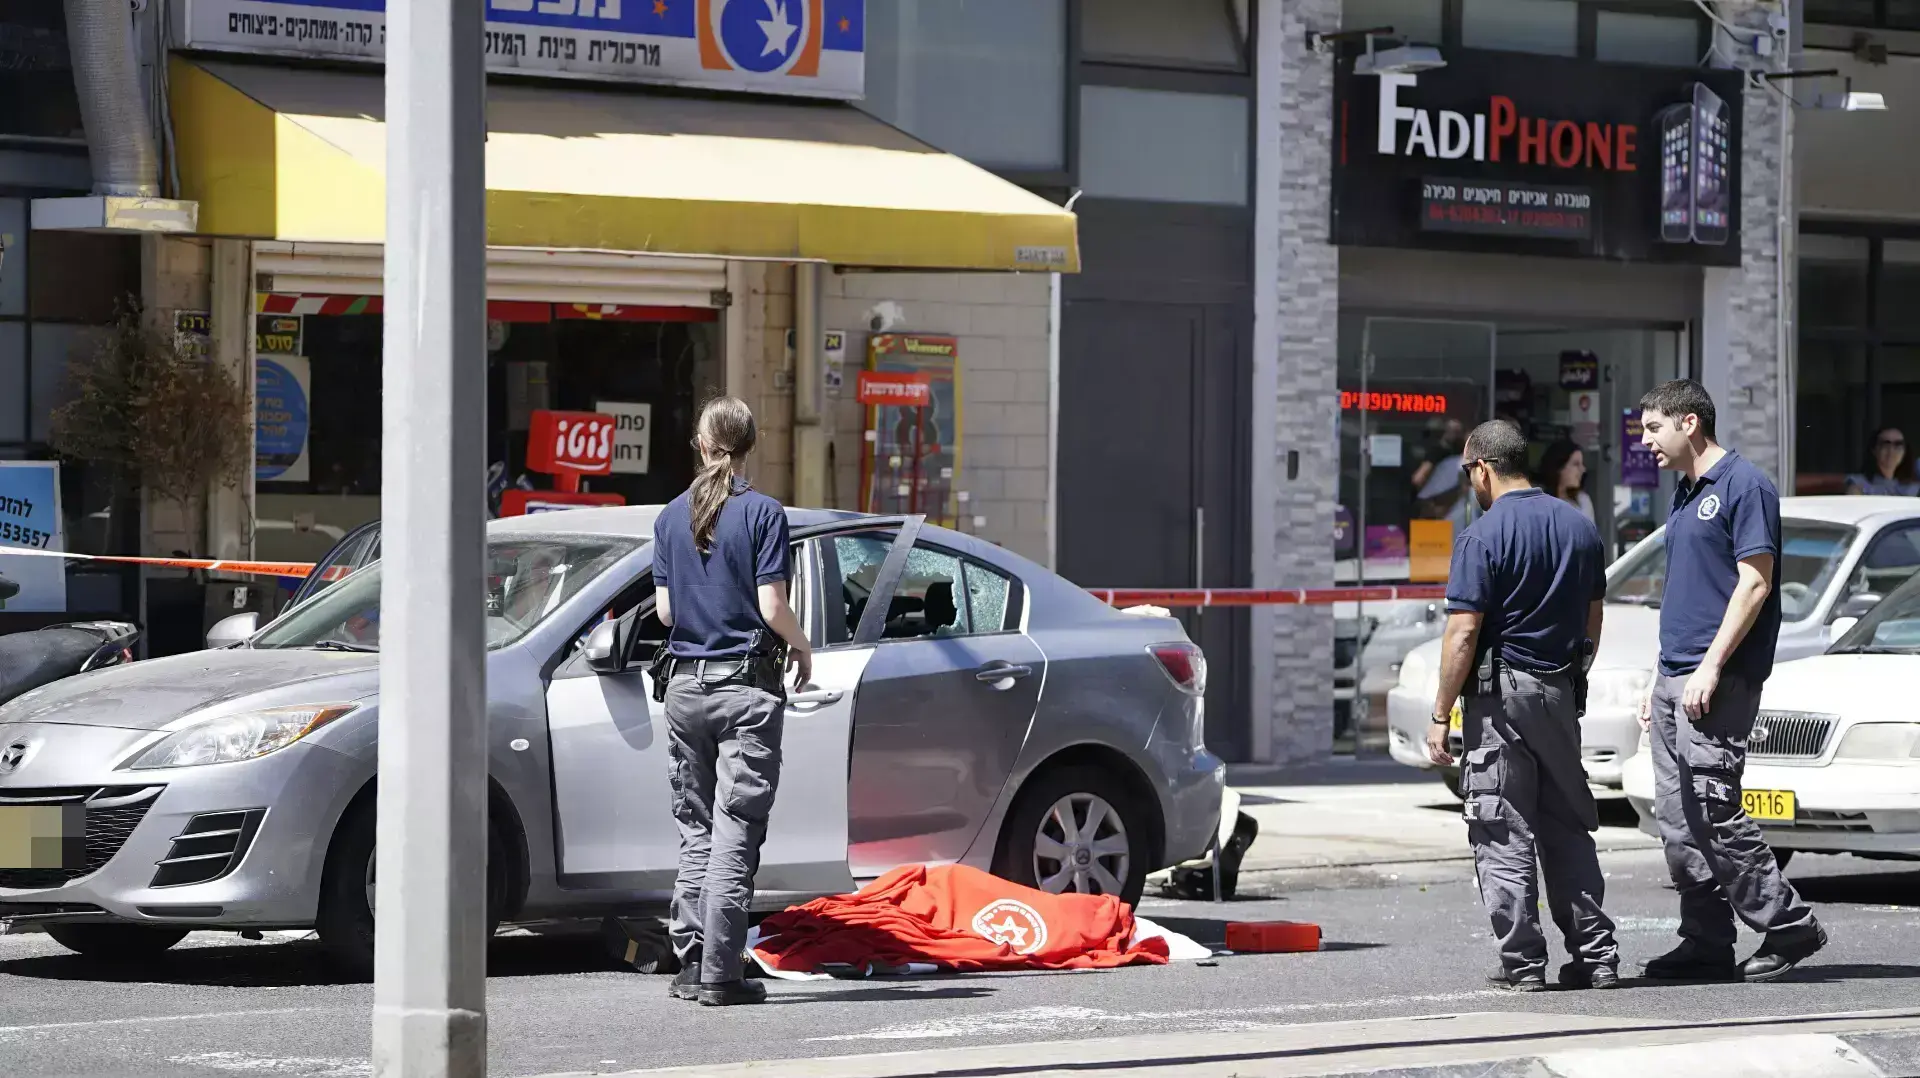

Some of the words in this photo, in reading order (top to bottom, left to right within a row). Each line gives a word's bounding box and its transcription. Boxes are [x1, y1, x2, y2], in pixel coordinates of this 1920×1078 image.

[345, 22, 373, 46] קרה
[537, 36, 576, 60] פינת
[588, 39, 661, 66] מרכולית
[615, 414, 645, 431] פתו
[614, 444, 643, 460] דחו
[0, 521, 51, 549] 53557
